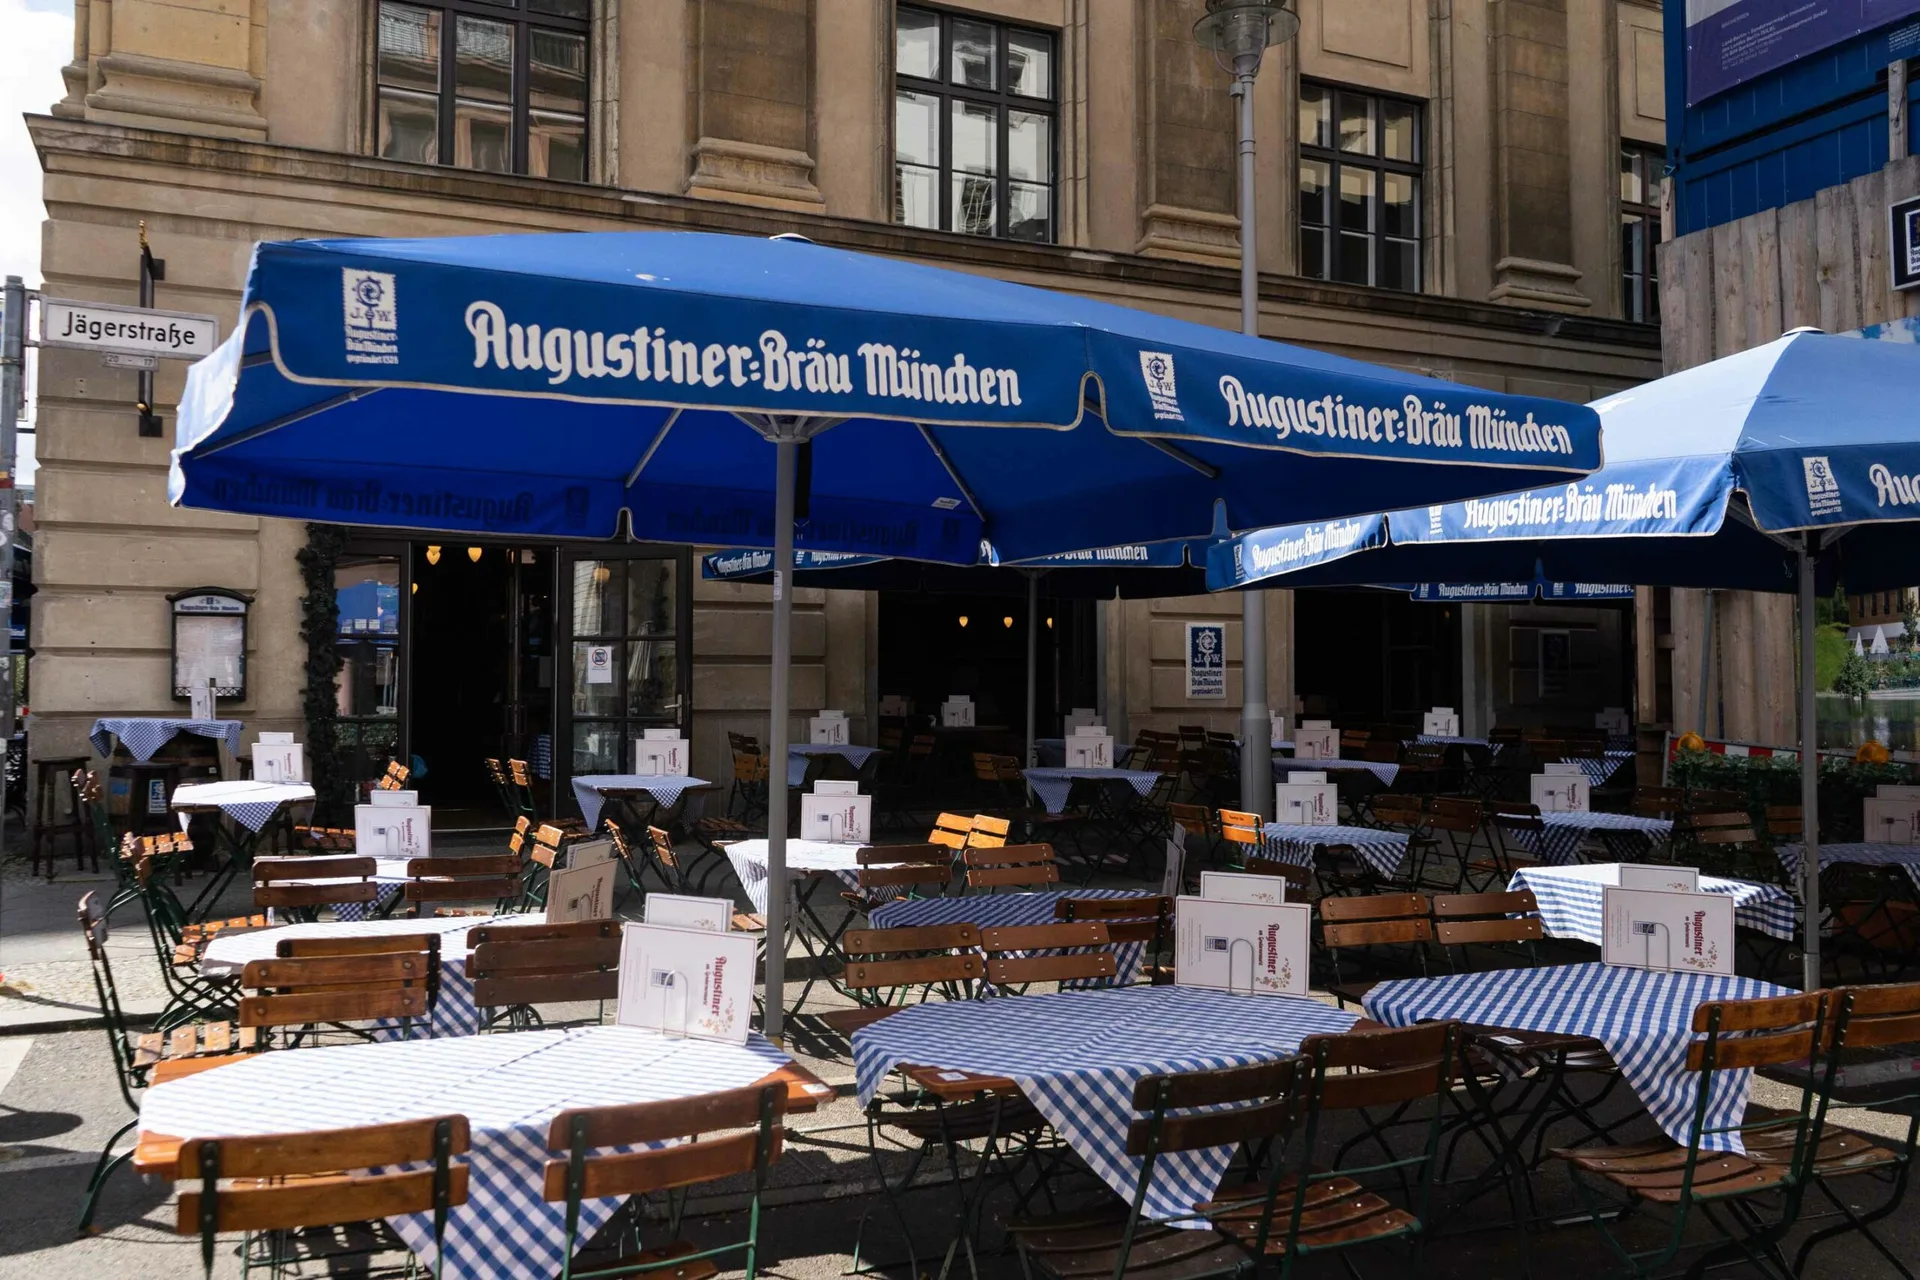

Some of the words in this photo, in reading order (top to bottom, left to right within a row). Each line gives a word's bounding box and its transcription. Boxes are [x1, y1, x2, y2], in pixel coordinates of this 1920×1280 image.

[62, 311, 196, 348] Jägerstraße
[858, 342, 1022, 407] München
[1466, 404, 1574, 455] München
[1605, 483, 1677, 522] München
[1266, 923, 1280, 974] Augustiner
[1692, 910, 1706, 956] Augustiner
[711, 956, 728, 1016] Augustiner
